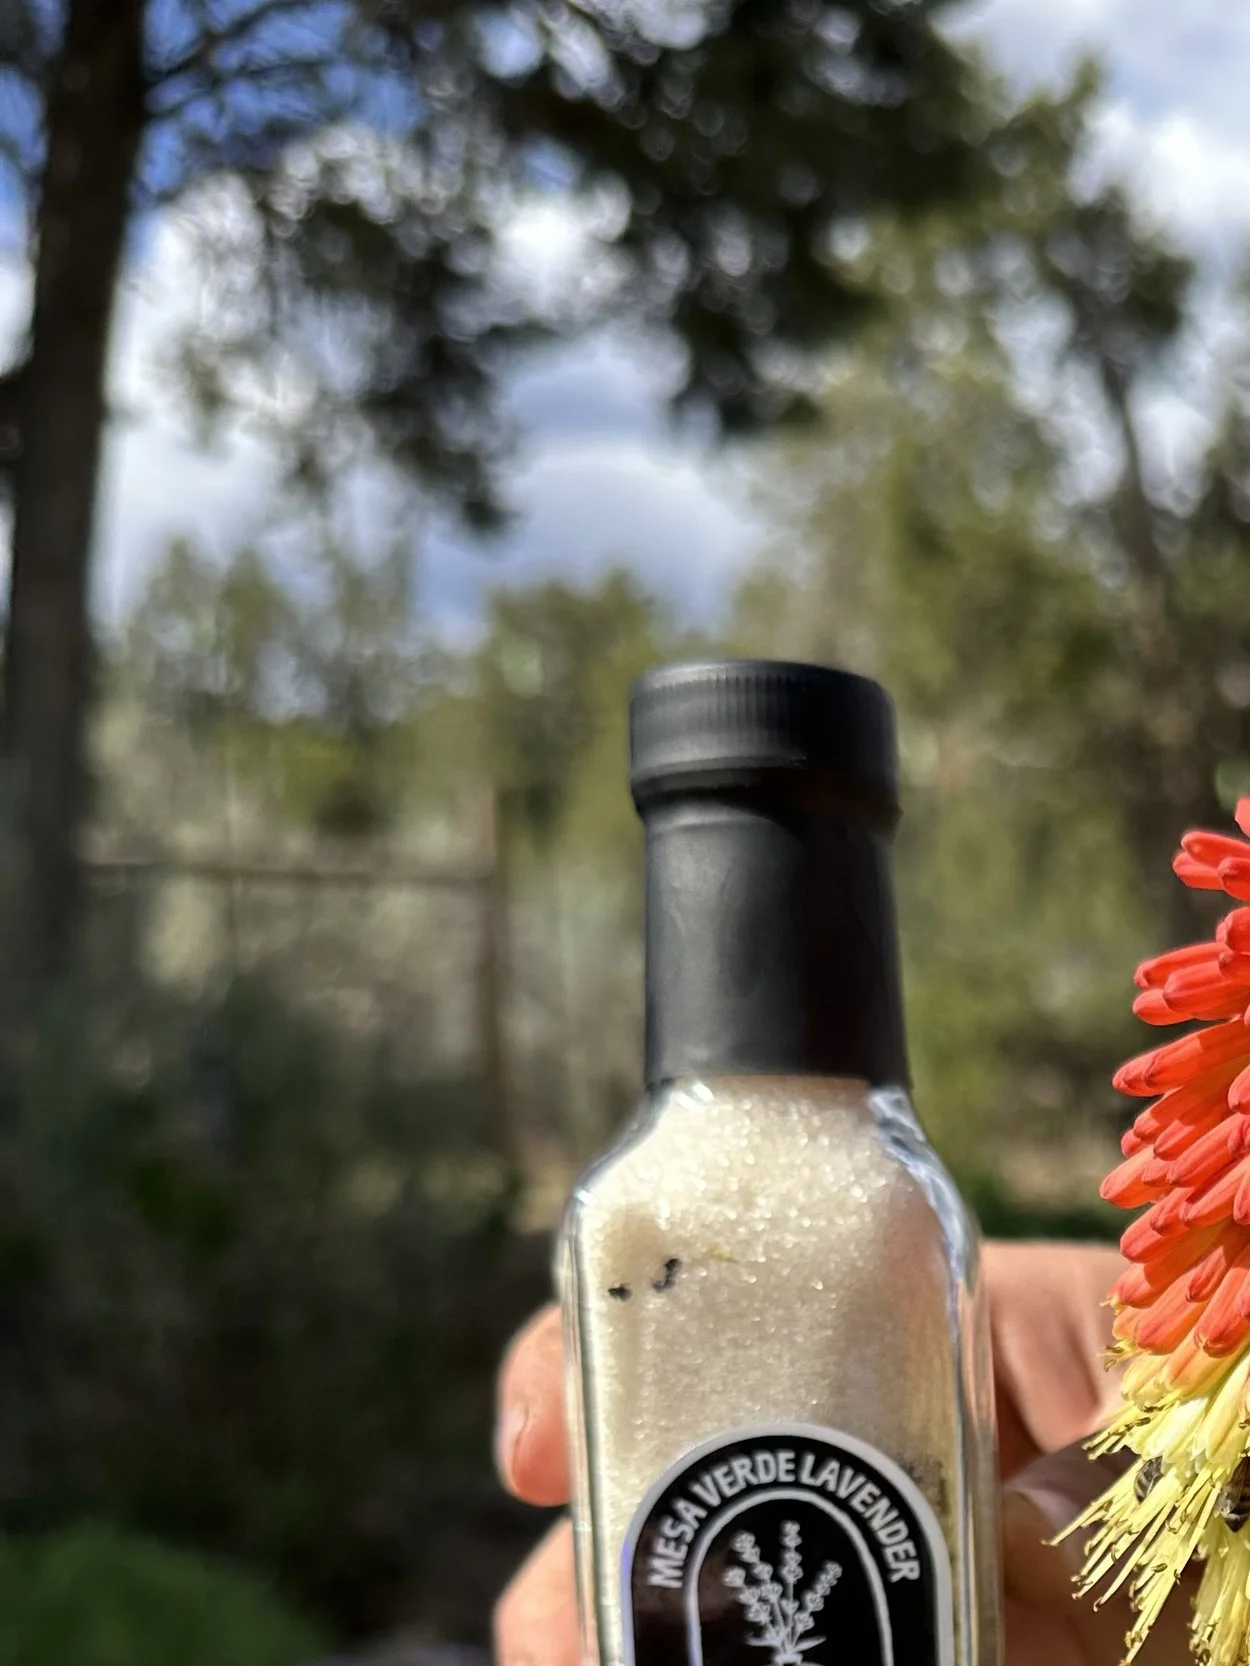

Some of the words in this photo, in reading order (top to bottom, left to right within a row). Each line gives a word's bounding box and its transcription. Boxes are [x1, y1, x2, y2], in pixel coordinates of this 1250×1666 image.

[646, 1501, 706, 1589] MESA
[690, 1449, 796, 1510] VERDE
[800, 1450, 920, 1583] LAVENDER
